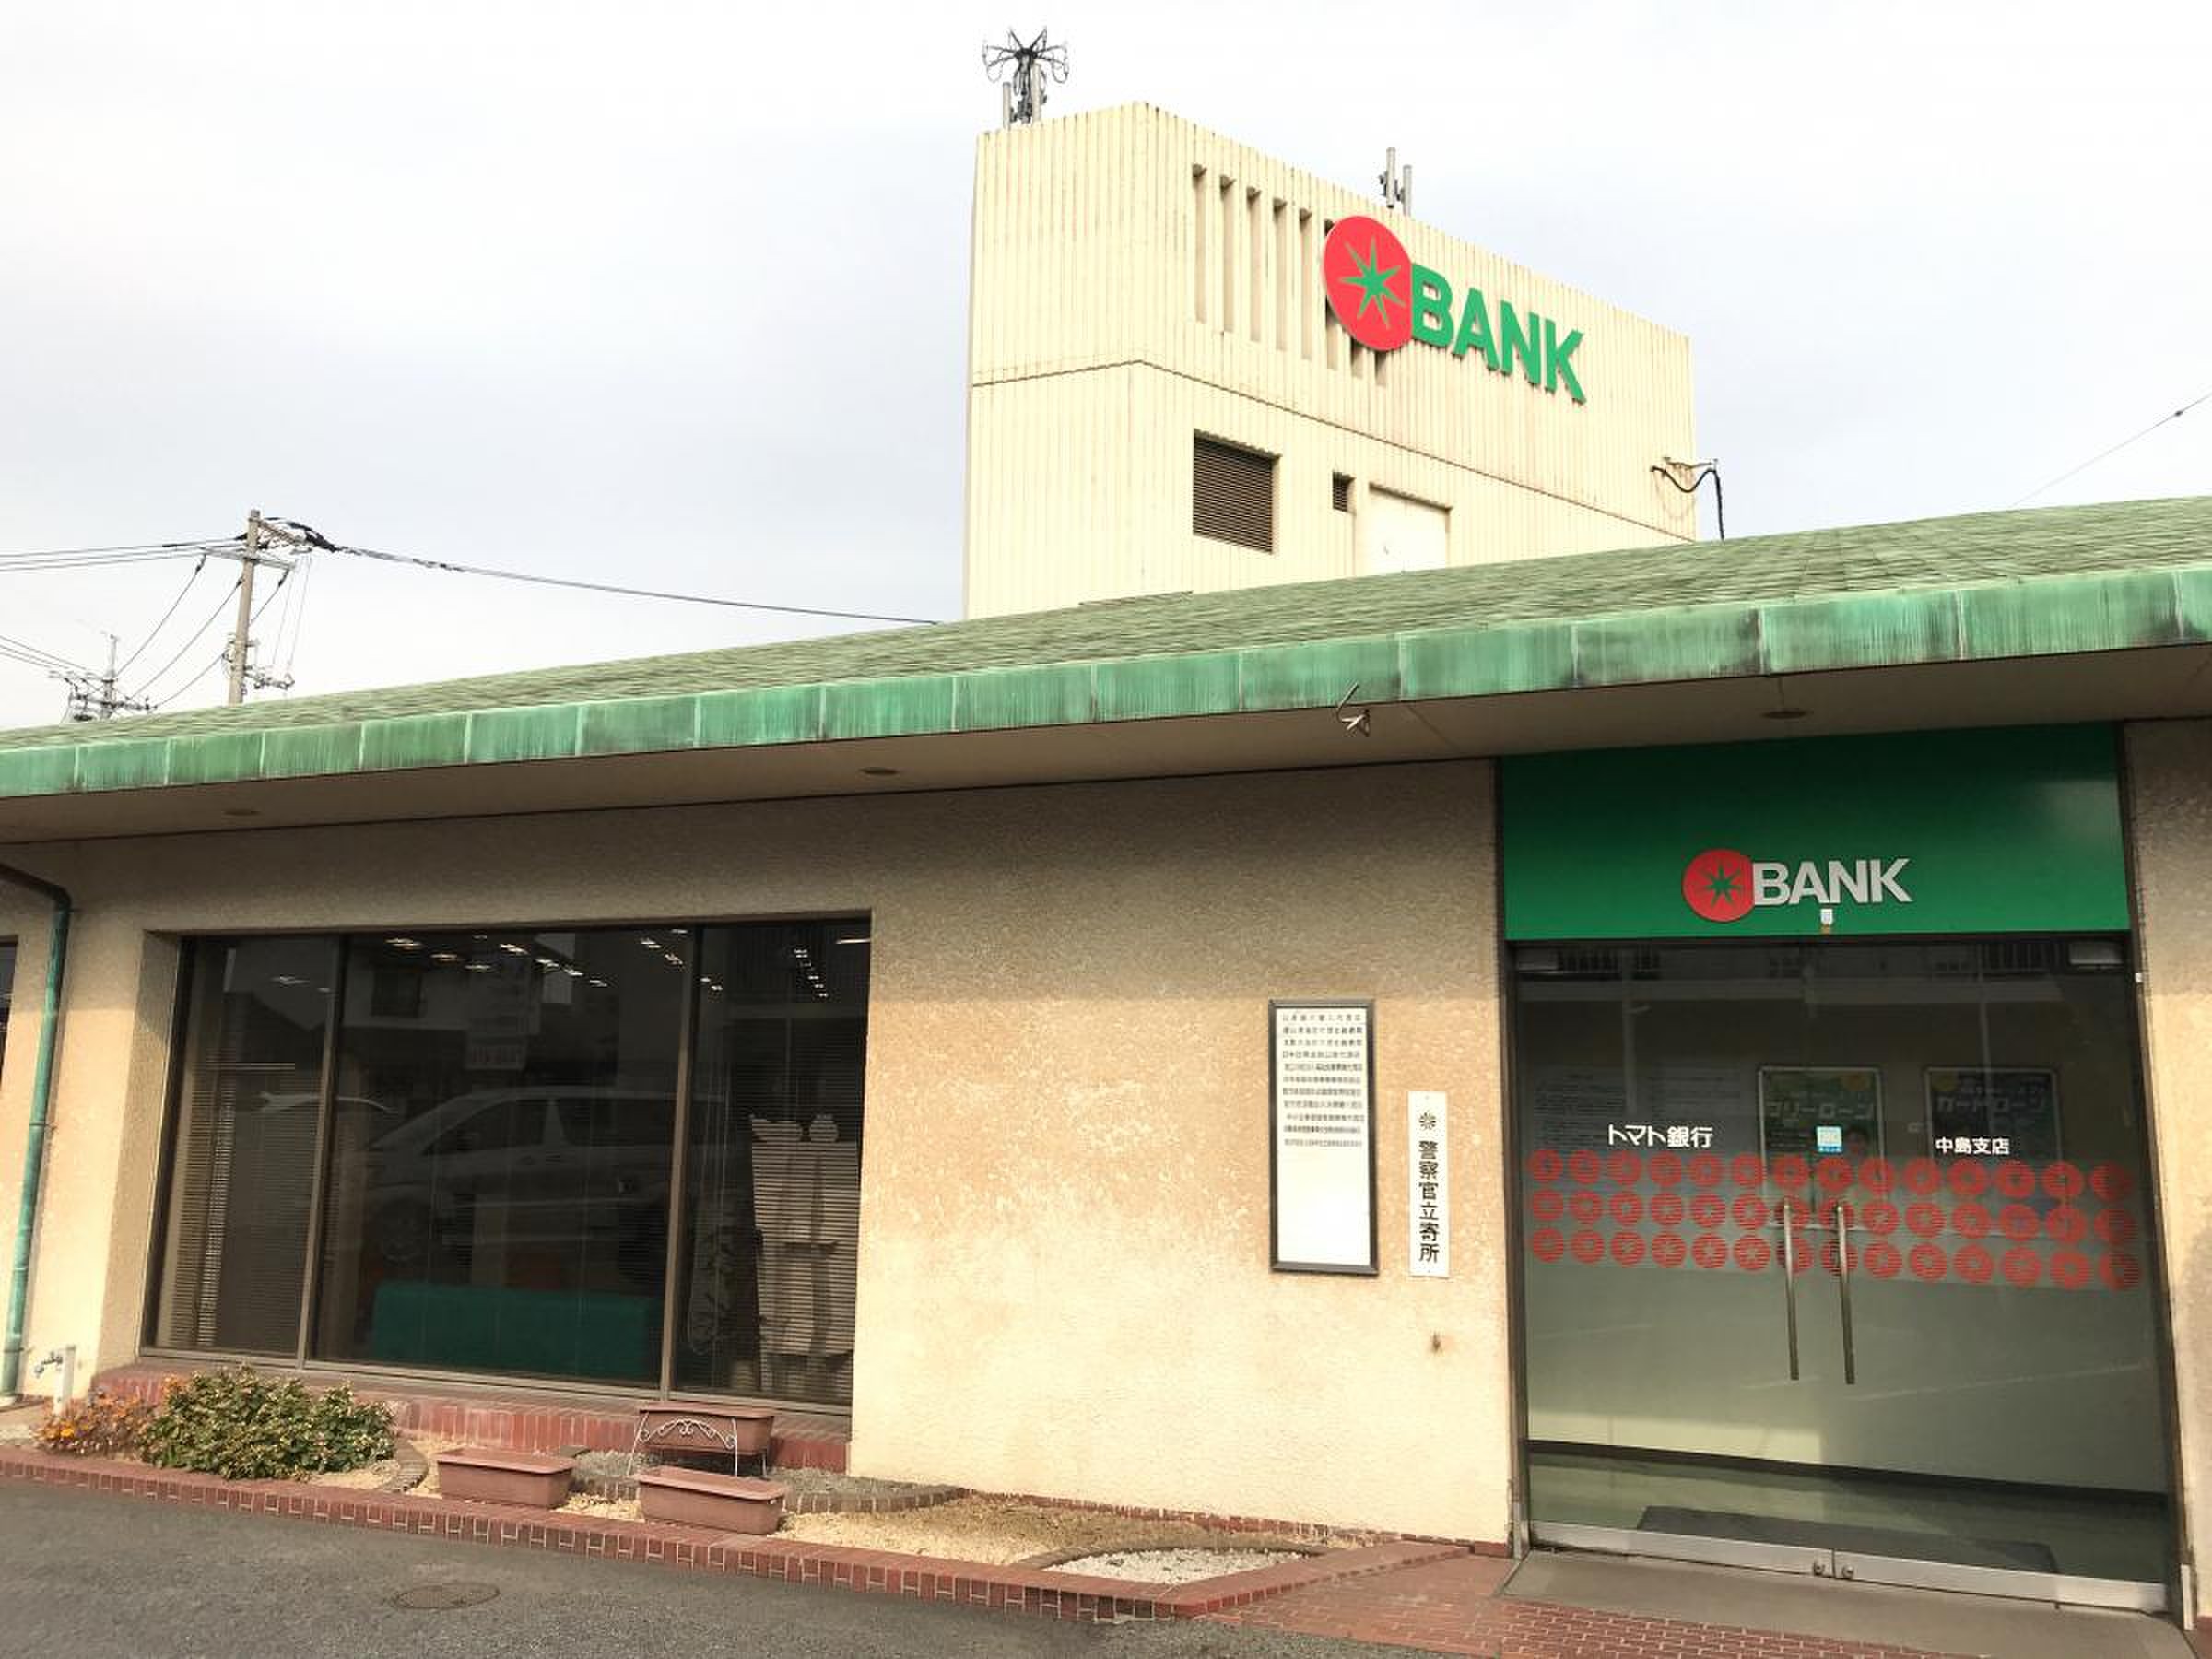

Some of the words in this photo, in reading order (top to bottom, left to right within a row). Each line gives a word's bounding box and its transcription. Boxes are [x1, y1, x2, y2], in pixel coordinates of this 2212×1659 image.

[1411, 264, 1586, 404] BANK
[1753, 858, 1914, 906] BANK
[1608, 1124, 1713, 1148] トマト銀行
[1936, 1136, 2010, 1155] 中島支店
[1418, 1140, 1440, 1263] 警察官立寄所
